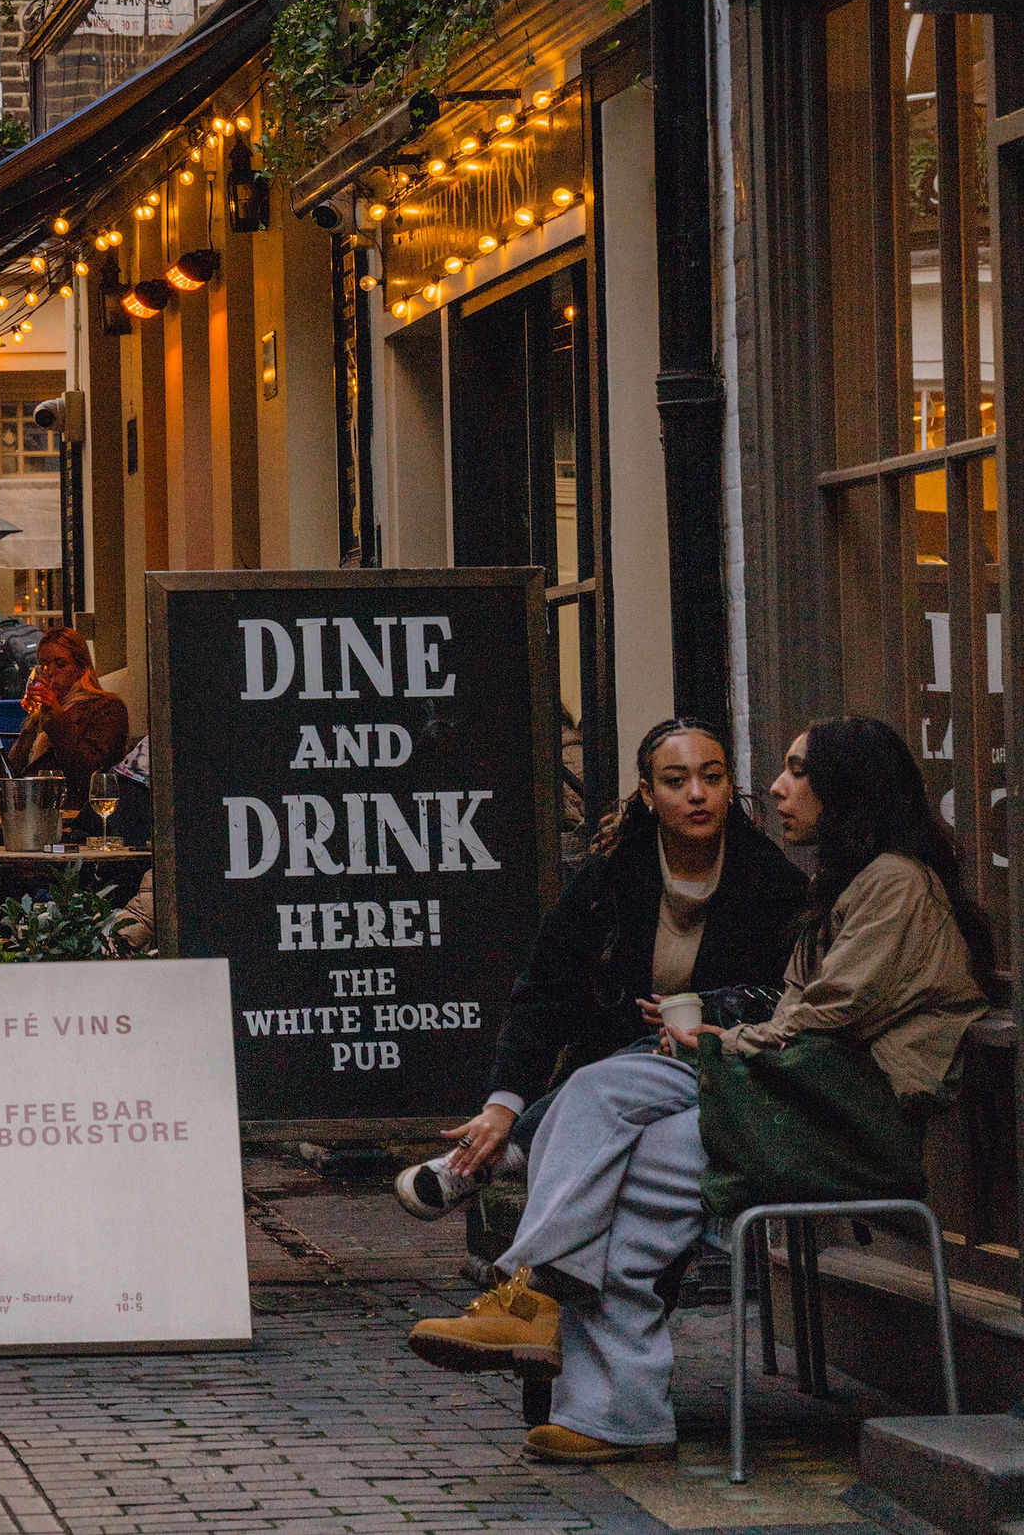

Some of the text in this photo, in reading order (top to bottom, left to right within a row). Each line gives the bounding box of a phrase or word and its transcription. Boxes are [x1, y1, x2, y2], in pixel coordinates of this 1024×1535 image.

[238, 616, 456, 700] DINE
[290, 724, 412, 769] AND
[222, 790, 501, 880] DRINK
[277, 900, 441, 951] HERE!
[329, 968, 397, 997] THE
[53, 1014, 132, 1036] VINS
[243, 1002, 482, 1037] WHITE HORSE
[331, 1041, 401, 1071] PUB
[92, 1099, 153, 1121] BAR
[23, 1293, 73, 1304] Saturday
